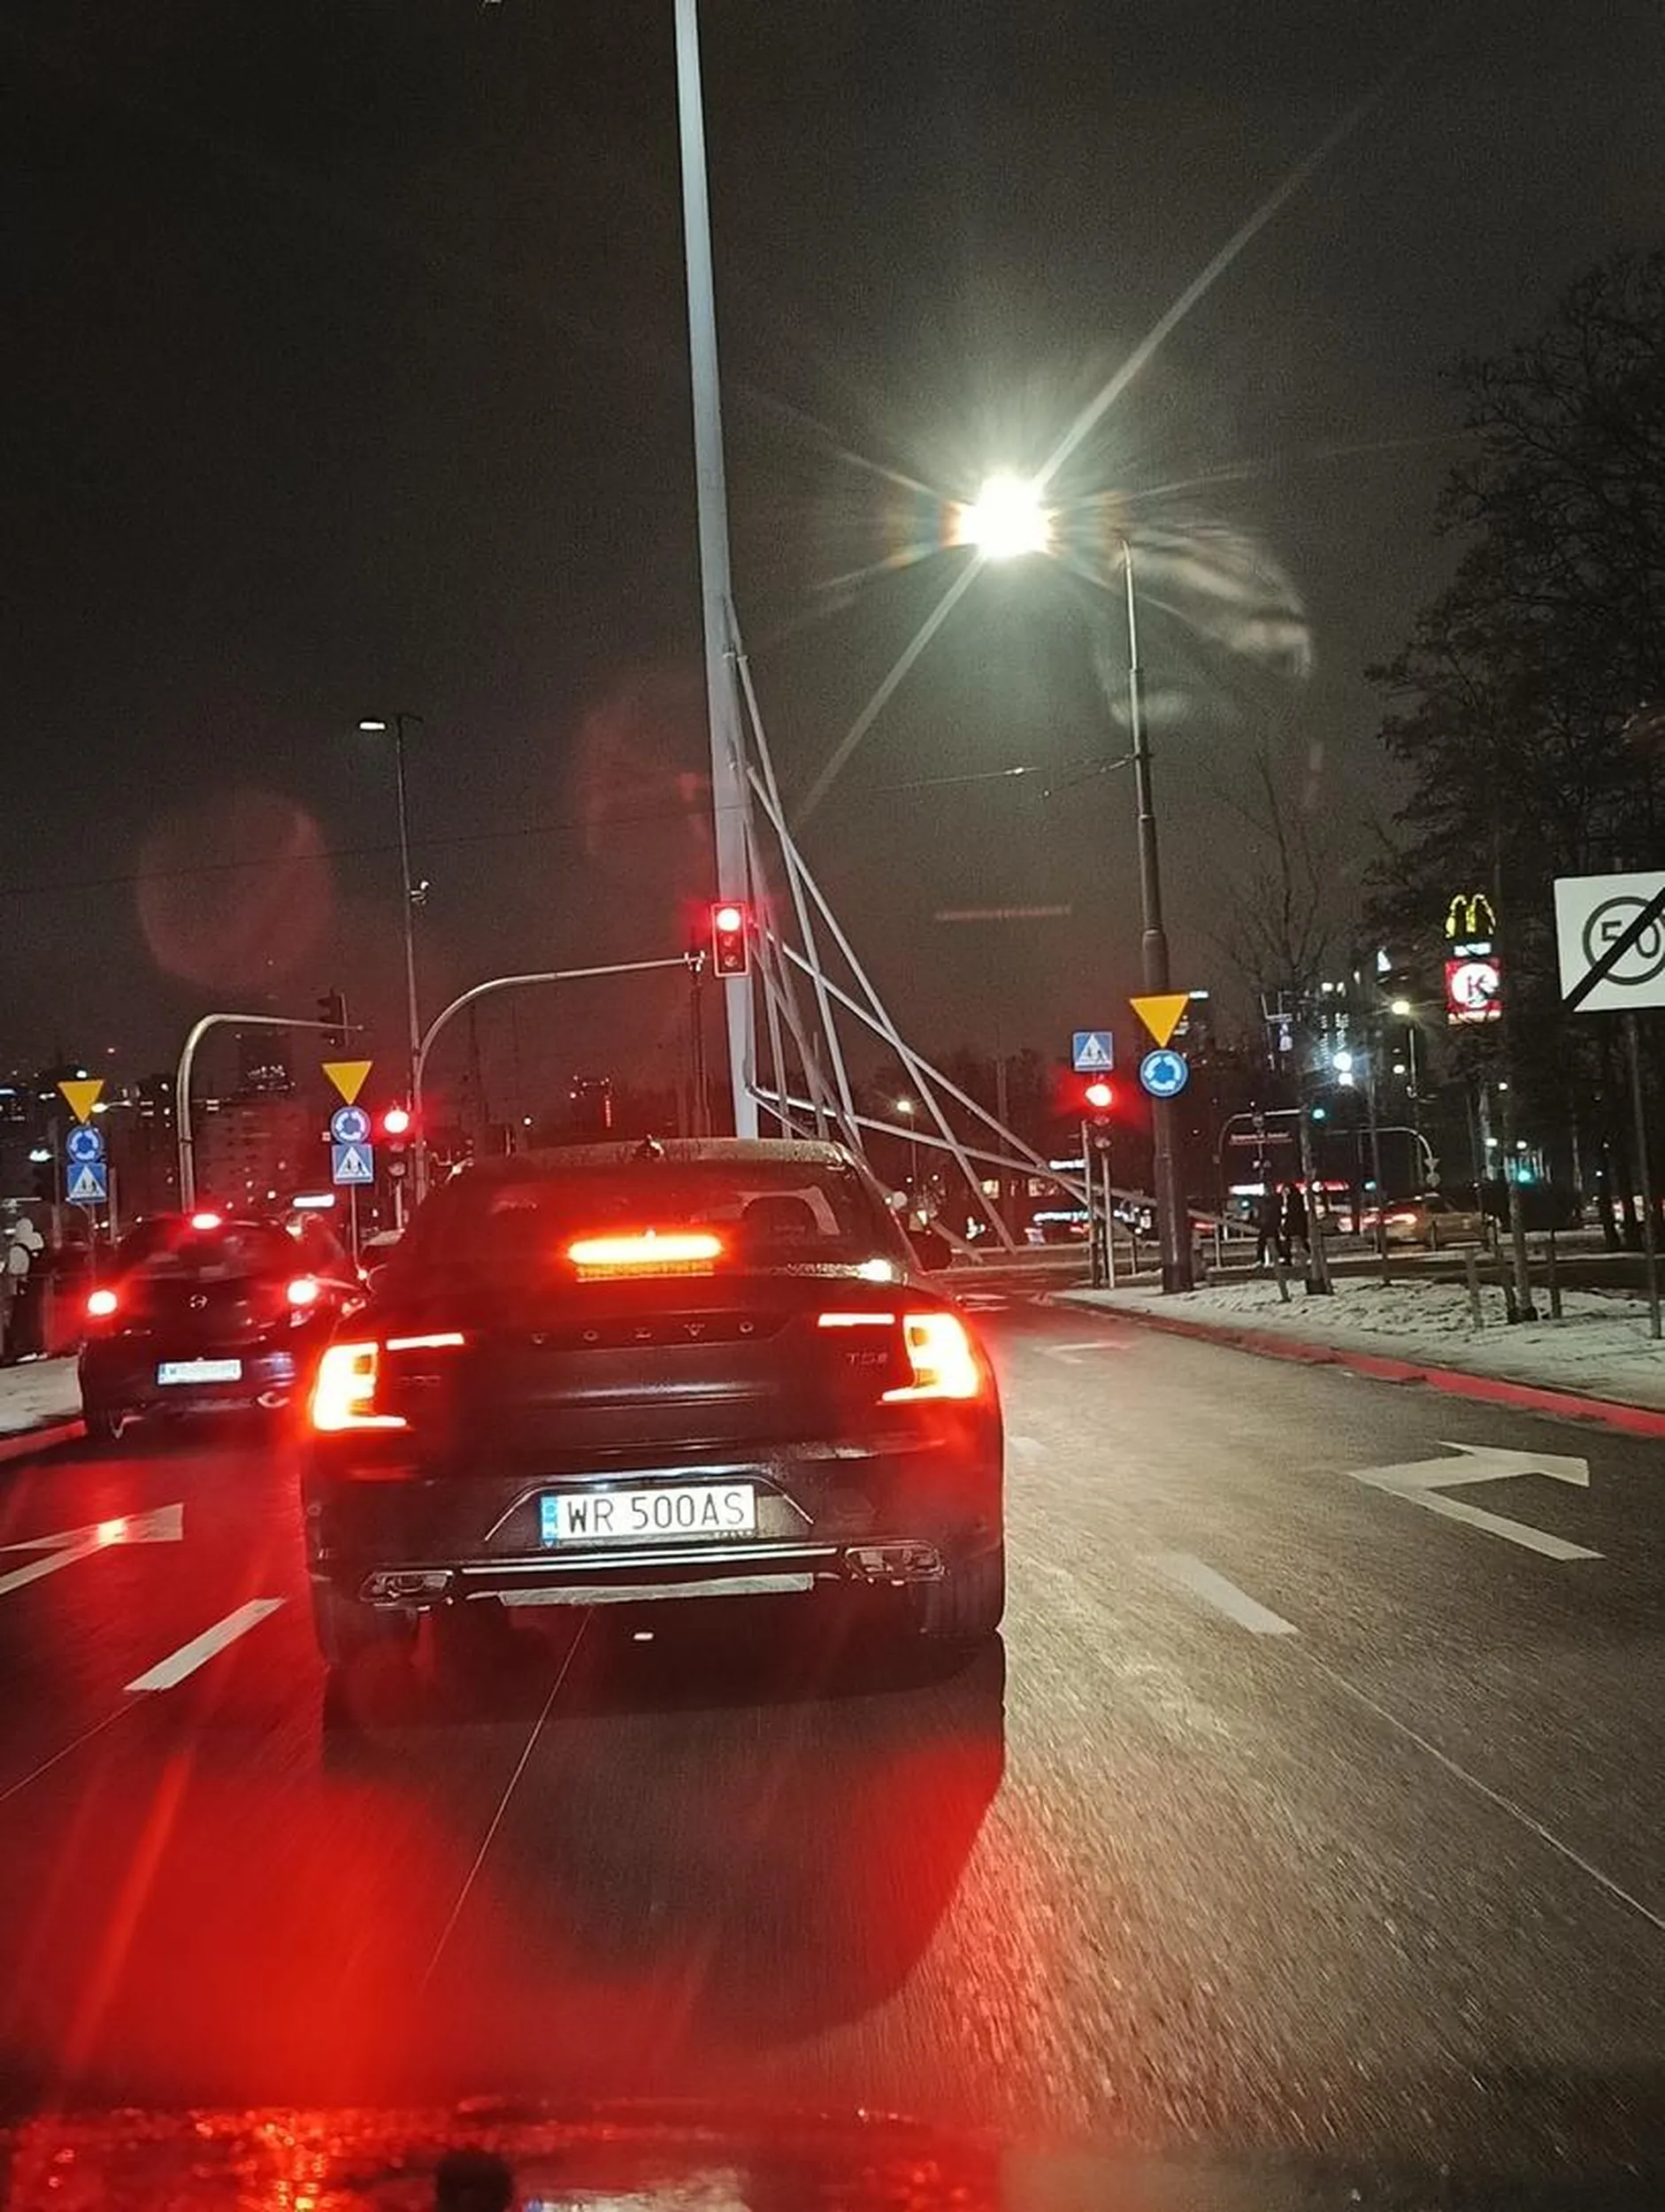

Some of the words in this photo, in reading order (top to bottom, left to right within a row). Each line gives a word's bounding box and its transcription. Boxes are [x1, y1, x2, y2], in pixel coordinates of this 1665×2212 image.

[1600, 918, 1661, 959] 50
[566, 1499, 614, 1533] WR
[631, 1492, 745, 1530] 500AS
